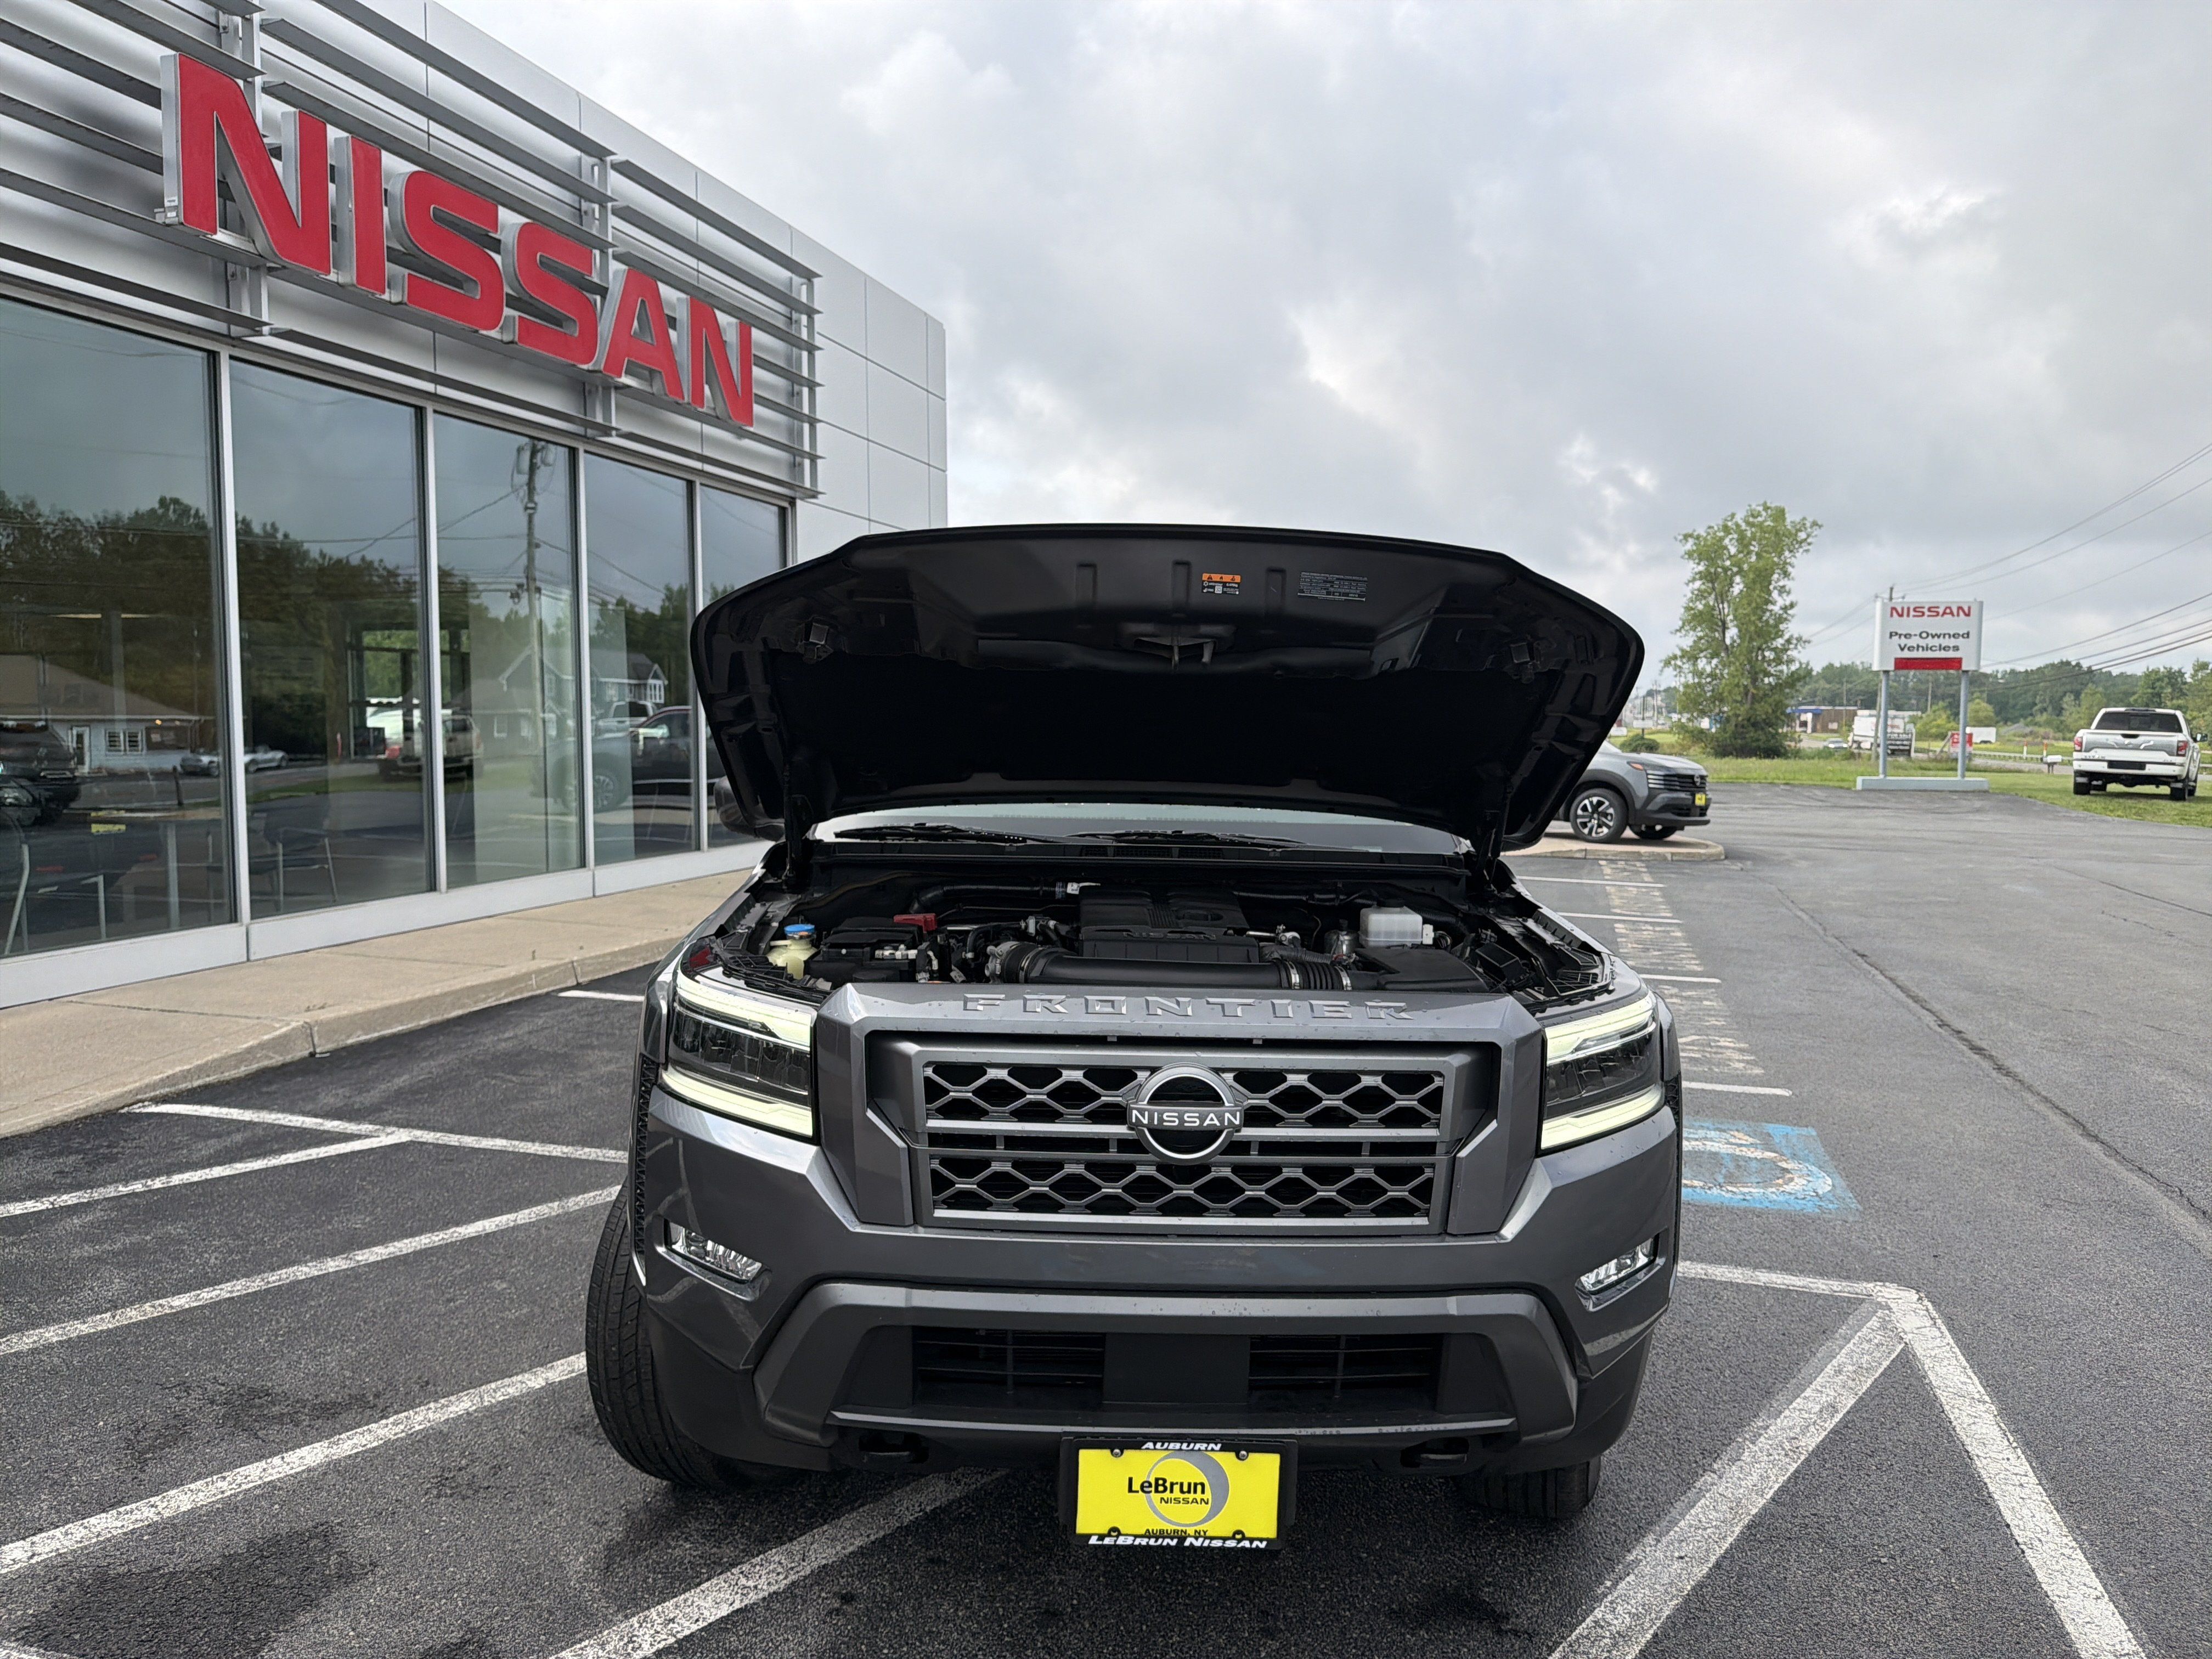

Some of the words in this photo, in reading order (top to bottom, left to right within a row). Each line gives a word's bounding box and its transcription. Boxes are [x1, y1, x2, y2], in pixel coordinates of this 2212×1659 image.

[177, 52, 754, 428] NISSAN
[1890, 606, 1972, 618] NISSAN
[1889, 630, 1971, 640] Pre-Owned
[1898, 644, 1960, 652] Vehicles
[963, 993, 1414, 1020] FRONTIER
[1131, 1109, 1241, 1127] NISSAN
[1141, 1442, 1221, 1451] AUBURN
[1127, 1477, 1206, 1494] LeBrun
